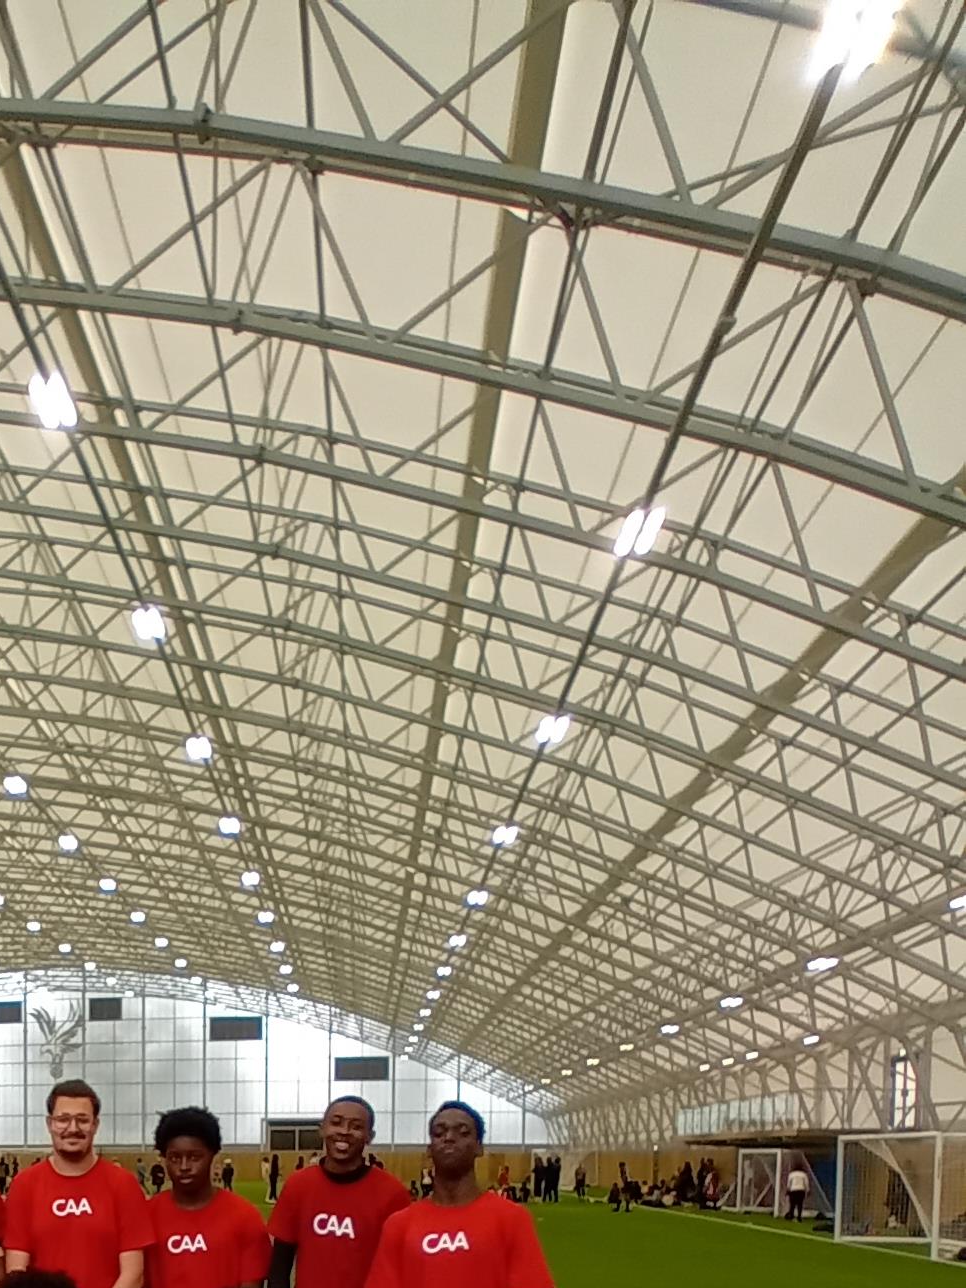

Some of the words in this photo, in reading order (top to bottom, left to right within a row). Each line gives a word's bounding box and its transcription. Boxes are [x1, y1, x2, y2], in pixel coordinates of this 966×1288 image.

[51, 1197, 93, 1217] CAA
[313, 1213, 355, 1239] CAA
[167, 1233, 208, 1254] CAA
[421, 1231, 470, 1254] CAA
